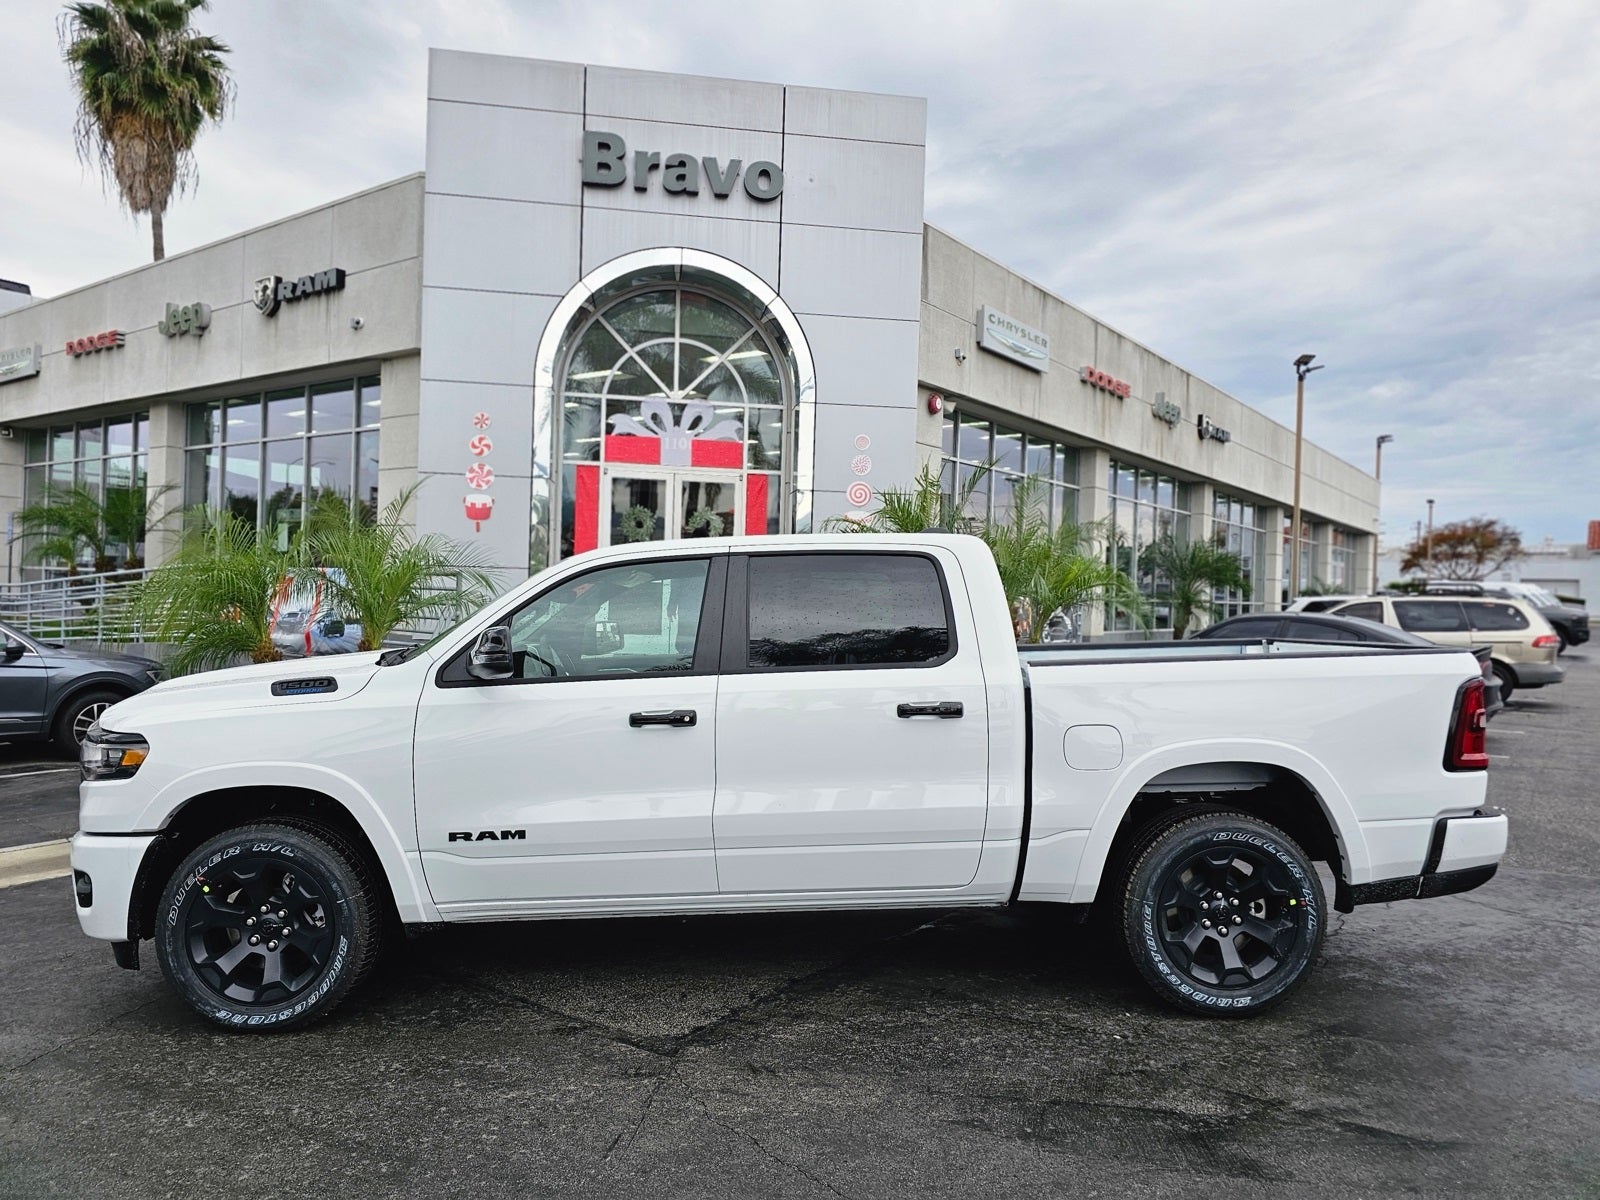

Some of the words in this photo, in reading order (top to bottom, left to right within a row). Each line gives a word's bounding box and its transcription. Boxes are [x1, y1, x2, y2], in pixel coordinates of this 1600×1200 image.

[582, 130, 784, 202] Bravo
[277, 268, 346, 301] RAM
[158, 302, 210, 336] Jeep
[988, 313, 1048, 347] CHRYSLER
[66, 329, 124, 357] DODGE
[1082, 366, 1131, 398] DODGE
[663, 437, 691, 451] 110
[280, 680, 329, 689] 1500
[448, 829, 526, 842] RAM
[168, 845, 241, 926] DUELER
[252, 843, 295, 857] H/L
[1213, 831, 1303, 878] DUELER
[1302, 888, 1317, 930] H/L
[1143, 901, 1252, 1007] BRIDGESTONE
[215, 935, 349, 1025] BRIDGESTONE
